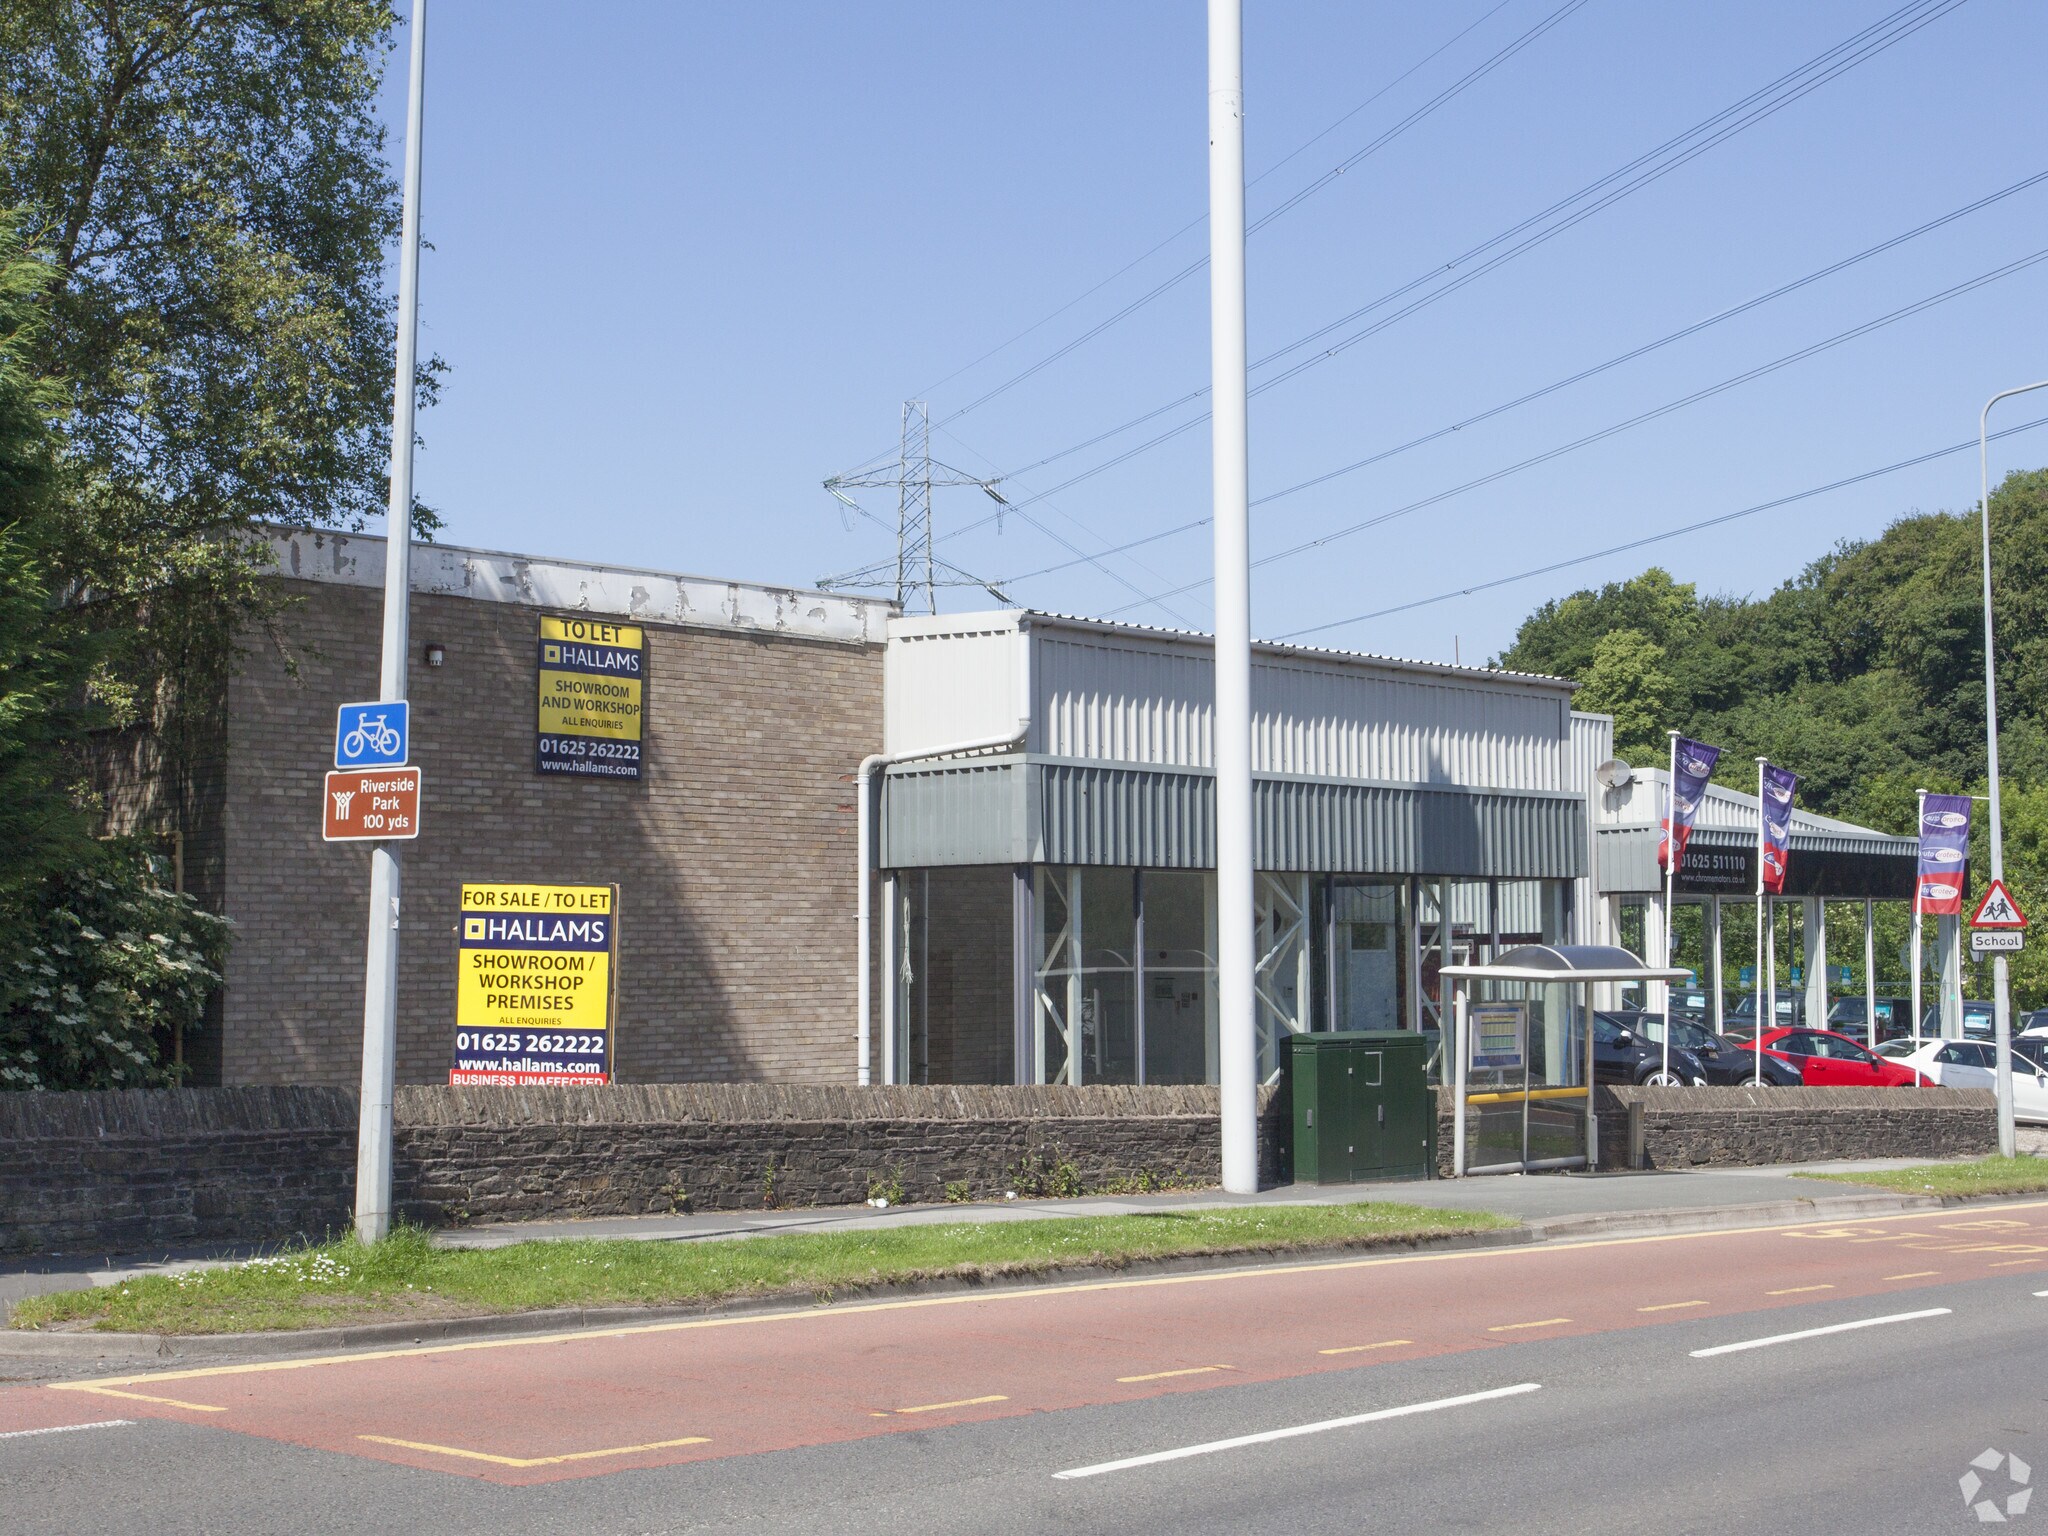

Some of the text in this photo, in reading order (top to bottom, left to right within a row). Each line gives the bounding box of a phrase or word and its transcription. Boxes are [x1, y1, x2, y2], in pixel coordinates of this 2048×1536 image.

[561, 620, 622, 643] TO LET
[563, 647, 638, 671] HALLAMS
[556, 680, 629, 698] SHOWROOM
[542, 696, 639, 715] AND WORKSHOP
[562, 717, 623, 729] ALL ENQUIRIES
[540, 739, 639, 760] 01625 262222
[542, 760, 637, 775] www.hallams.com
[361, 778, 414, 793] Riverside
[373, 797, 399, 810] Park
[364, 815, 408, 830] 100 yds
[1681, 854, 1745, 870] 01625 511110
[1681, 873, 1745, 883] www.chromemotors.co.uk
[464, 891, 608, 908] FOR SALE / TO LET
[489, 919, 604, 942] HALLAMS
[1976, 936, 2018, 945] School
[473, 955, 595, 971] SHOWROOM /
[480, 974, 583, 990] WORKSHOP
[487, 995, 573, 1010] PREMISES
[517, 1017, 561, 1025] ENQUIRIES
[457, 1033, 603, 1053] 01625 262222
[459, 1058, 600, 1073] www.hallams.com
[453, 1074, 604, 1086] BUSINESS UNAFFECTED
